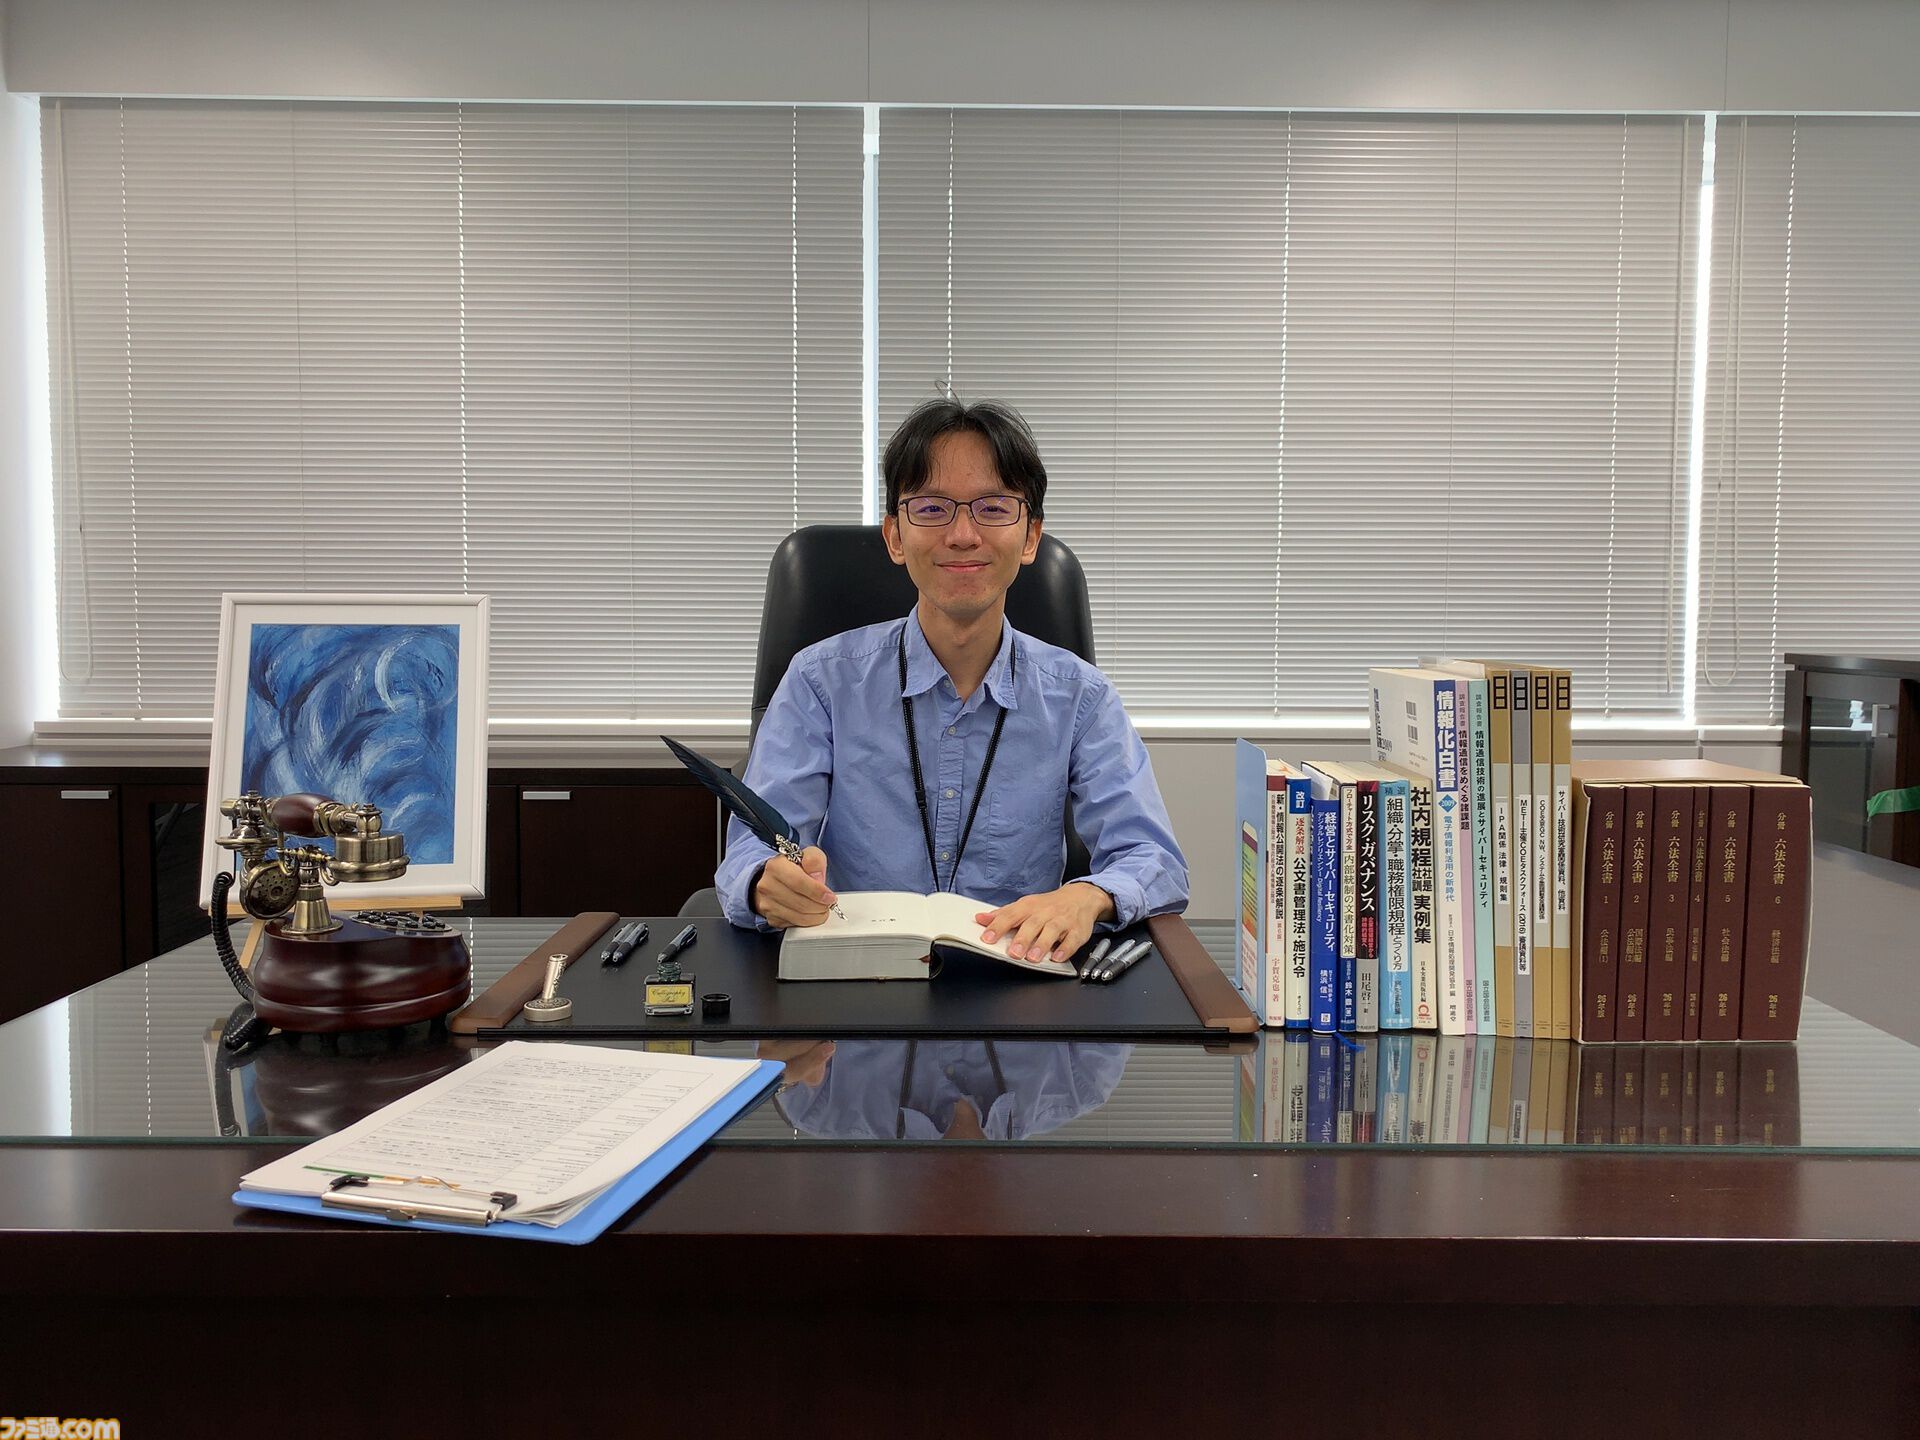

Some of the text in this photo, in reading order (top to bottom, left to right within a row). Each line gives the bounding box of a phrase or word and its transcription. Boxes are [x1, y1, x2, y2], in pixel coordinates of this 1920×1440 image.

[1436, 690, 1456, 788] 情報化白書
[1295, 791, 1305, 809] 改訂
[1458, 730, 1470, 830] 情報通信をめぐる諸課題
[1295, 817, 1305, 855] 逐条解説
[1411, 786, 1432, 867] 社内規程
[1475, 730, 1489, 908] 情報通信技術の進展とサイバーセキュリティ
[1275, 794, 1285, 920] 新・情報公開法の逐条解説
[1360, 795, 1376, 912] リスク・ガバナンス
[1443, 816, 1455, 902] 電子情報利活用の新時代
[1498, 807, 1508, 902] IPA関係 法律・規則集
[1601, 837, 1614, 884] 六法全書
[1632, 837, 1645, 884] 六法全書
[1667, 837, 1681, 883] 六法全書
[1694, 837, 1705, 883] 六法全書
[1723, 837, 1737, 884] 六法全書
[1773, 838, 1787, 885] 六法全書
[1324, 812, 1337, 952] 経営とサイバーセキュリティ
[1344, 855, 1354, 954] 内部統制の文書化対策
[1603, 895, 1608, 904] 1
[1633, 895, 1639, 904] 2
[1669, 895, 1675, 904] 3
[1695, 895, 1700, 904] 4
[1725, 895, 1731, 904] 5
[1775, 896, 1781, 905] 6
[1293, 857, 1306, 978] 公文書管理法・施行令
[1413, 895, 1432, 944] 実例集
